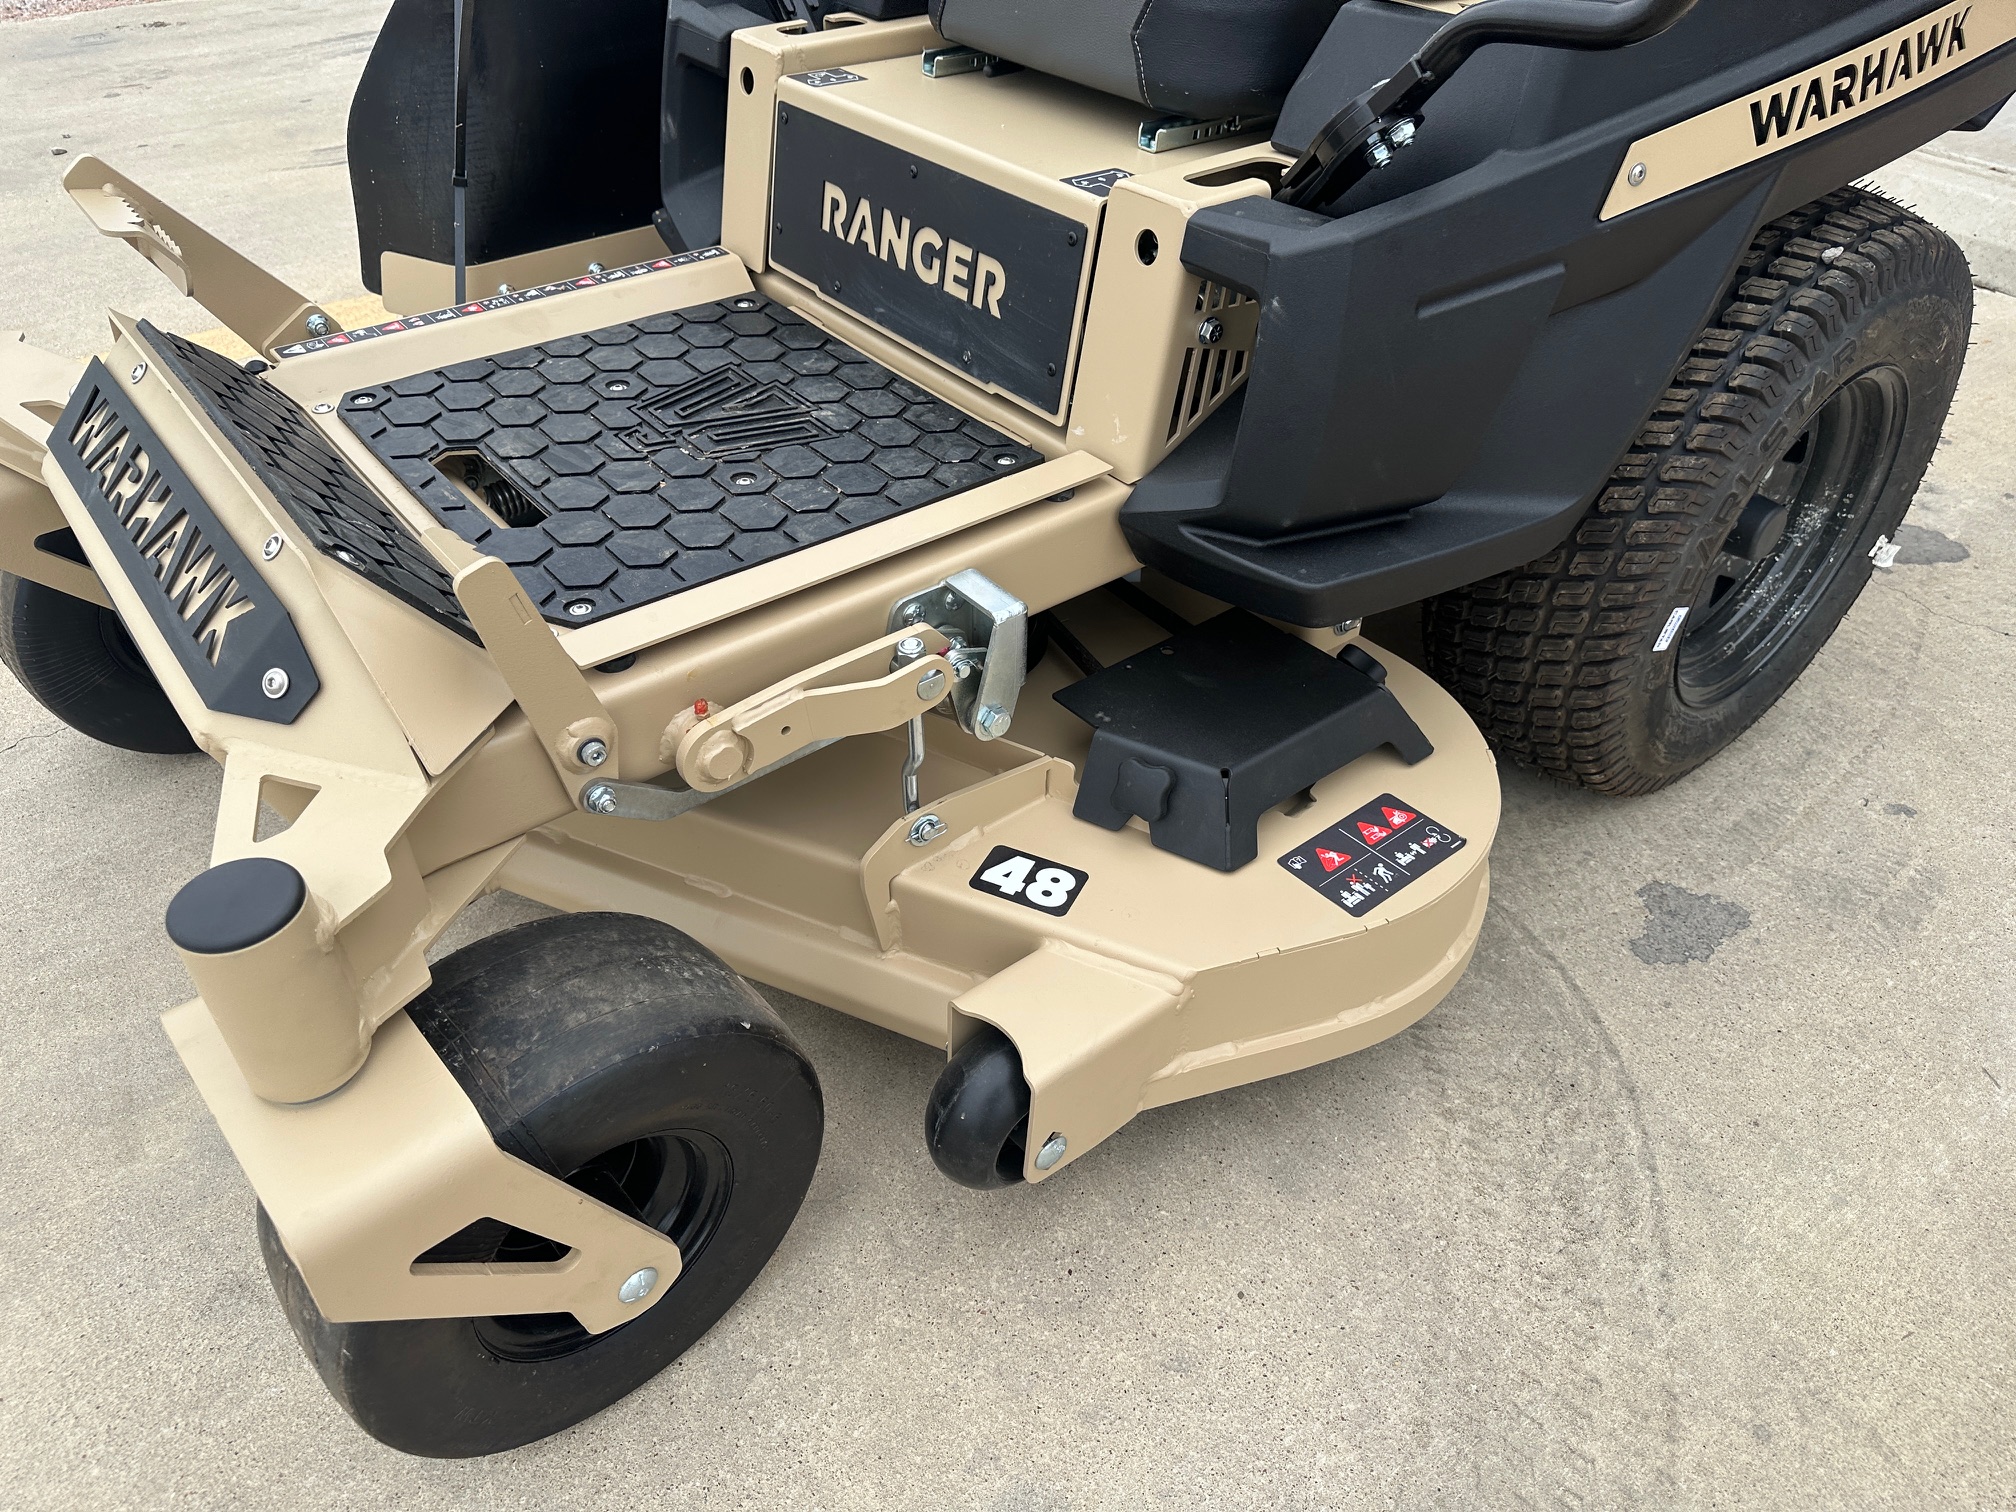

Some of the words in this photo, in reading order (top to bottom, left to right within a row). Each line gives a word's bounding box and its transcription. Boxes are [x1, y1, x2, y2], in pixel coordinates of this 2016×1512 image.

[1750, 5, 1973, 147] WARHAWK
[821, 180, 1006, 319] RANGER
[67, 384, 256, 669] WARHAWK
[980, 855, 1076, 907] 48
